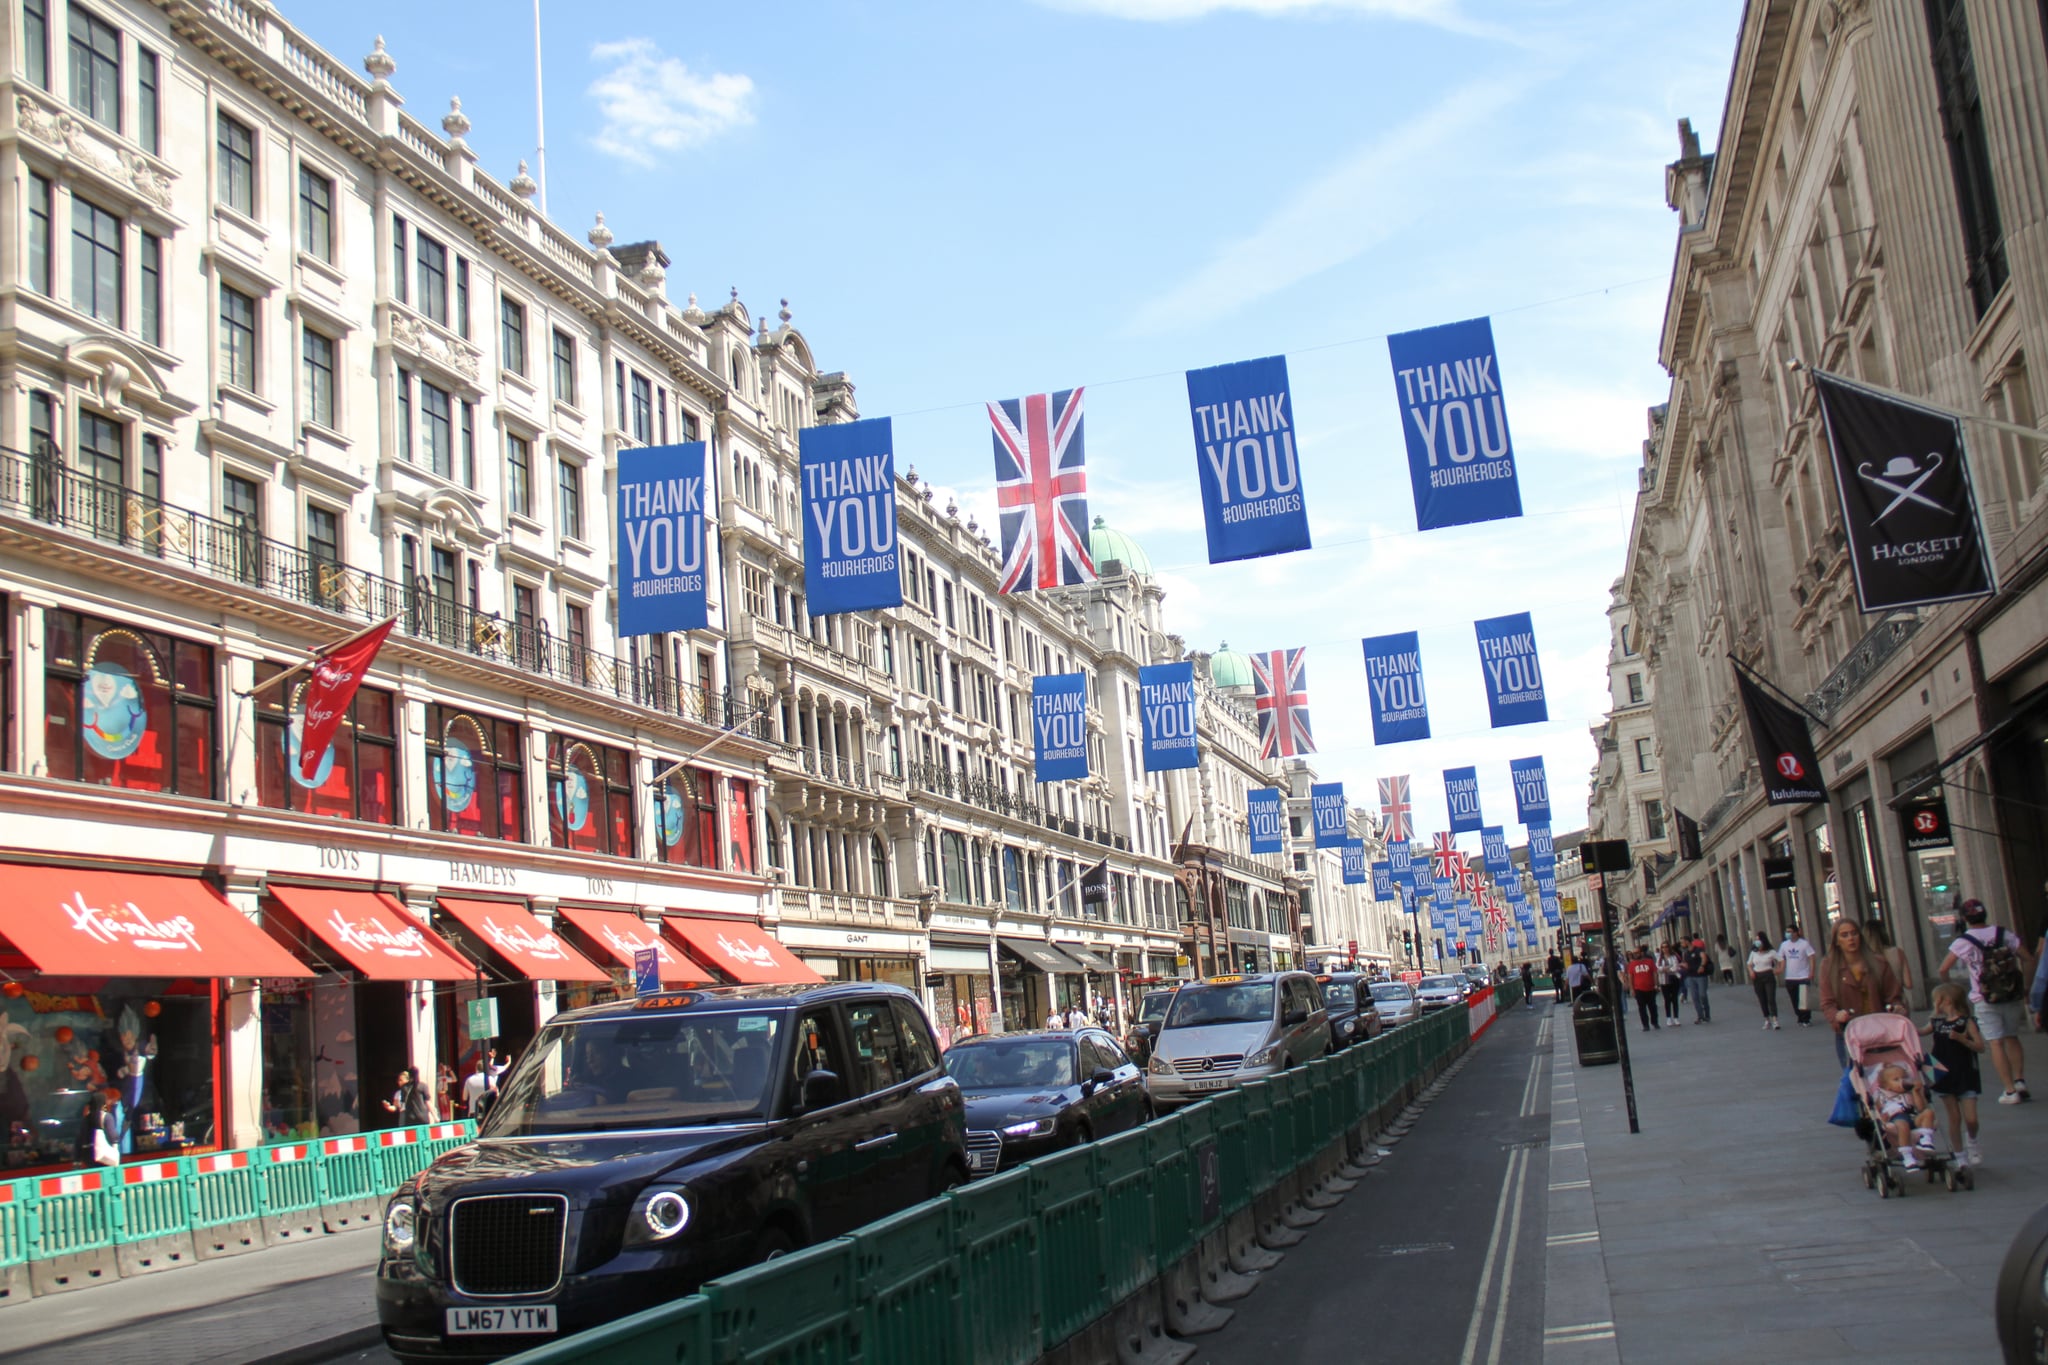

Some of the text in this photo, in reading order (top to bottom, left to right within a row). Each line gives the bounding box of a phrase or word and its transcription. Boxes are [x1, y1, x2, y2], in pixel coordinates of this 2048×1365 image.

[1398, 355, 1498, 405] THANK
[1196, 392, 1289, 443] THANK
[1410, 395, 1508, 467] YOU
[804, 454, 891, 499] THANK
[1205, 431, 1297, 504] YOU
[1430, 460, 1512, 489] #OURHEROES
[620, 476, 700, 519] THANK
[1223, 494, 1301, 524] #OURHEROES
[811, 493, 894, 559] YOU
[625, 513, 700, 579] YOU
[1872, 535, 1963, 561] HACKETT
[822, 553, 895, 578] #OURHEROES
[1898, 552, 1944, 566] LONDON
[633, 575, 702, 598] #OURHEROES
[1480, 632, 1534, 660] THANK
[1367, 651, 1420, 678] THANK
[1487, 654, 1540, 694] YOU
[1035, 692, 1083, 715] THANK
[1142, 681, 1193, 705] THANK
[1372, 673, 1424, 712] YOU
[1498, 689, 1544, 705] #OURHEROES
[1146, 703, 1194, 740] YOU
[1381, 707, 1426, 723] #OURHEROES
[1038, 713, 1084, 749] YOU
[1044, 747, 1085, 761] #OURHEROES
[1152, 736, 1195, 751] #OURHEROES
[1446, 778, 1477, 793] THANK
[1513, 767, 1545, 783] THANK
[1313, 794, 1343, 809] THANK
[1449, 791, 1480, 814] YOU
[1516, 781, 1548, 804] YOU
[1772, 788, 1821, 801] lululemon
[1249, 801, 1279, 815] THANK
[1315, 807, 1345, 830] YOU
[1251, 814, 1280, 835] YOU
[1529, 828, 1551, 839] THANK
[1388, 843, 1409, 854] THANK
[1482, 834, 1504, 845] THANK
[1484, 842, 1506, 859] YOU
[1531, 837, 1553, 853] YOU
[1909, 836, 1949, 848] lululemon
[317, 847, 359, 872] TOYS
[1342, 847, 1363, 856] THANK
[1343, 855, 1364, 871] YOU
[1389, 853, 1411, 868] YOU
[450, 861, 516, 886] HAMLEYS
[1413, 872, 1432, 886] YOU
[586, 877, 613, 896] TOYS
[1085, 883, 1107, 893] BOSS
[1436, 890, 1453, 903] YOU
[60, 891, 202, 952] Hamleys
[327, 909, 433, 958] Hamleys
[482, 916, 570, 961] Hamleys
[847, 935, 869, 944] GANT
[640, 997, 685, 1008] TAXI
[455, 1308, 548, 1330] LM67 YTW
